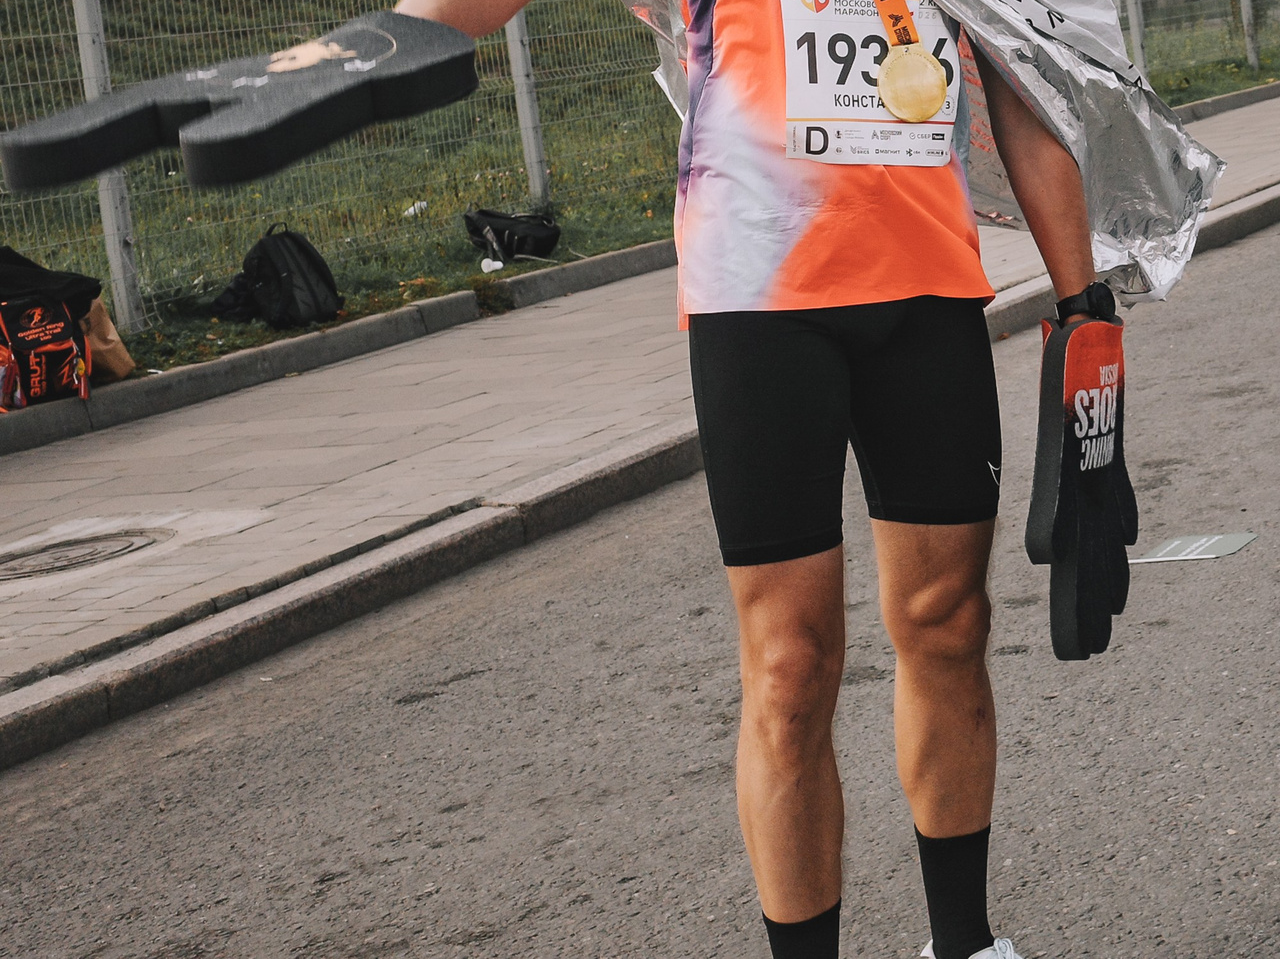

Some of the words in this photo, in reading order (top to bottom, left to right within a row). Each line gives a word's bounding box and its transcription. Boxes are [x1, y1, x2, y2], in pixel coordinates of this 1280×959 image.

[834, 0, 876, 8] МОСКОВС
[834, 8, 880, 16] МАРАФОН
[796, 31, 954, 87] 1936
[834, 94, 886, 109] КОНСТА
[805, 126, 829, 155] D
[18, 327, 45, 337] Golden
